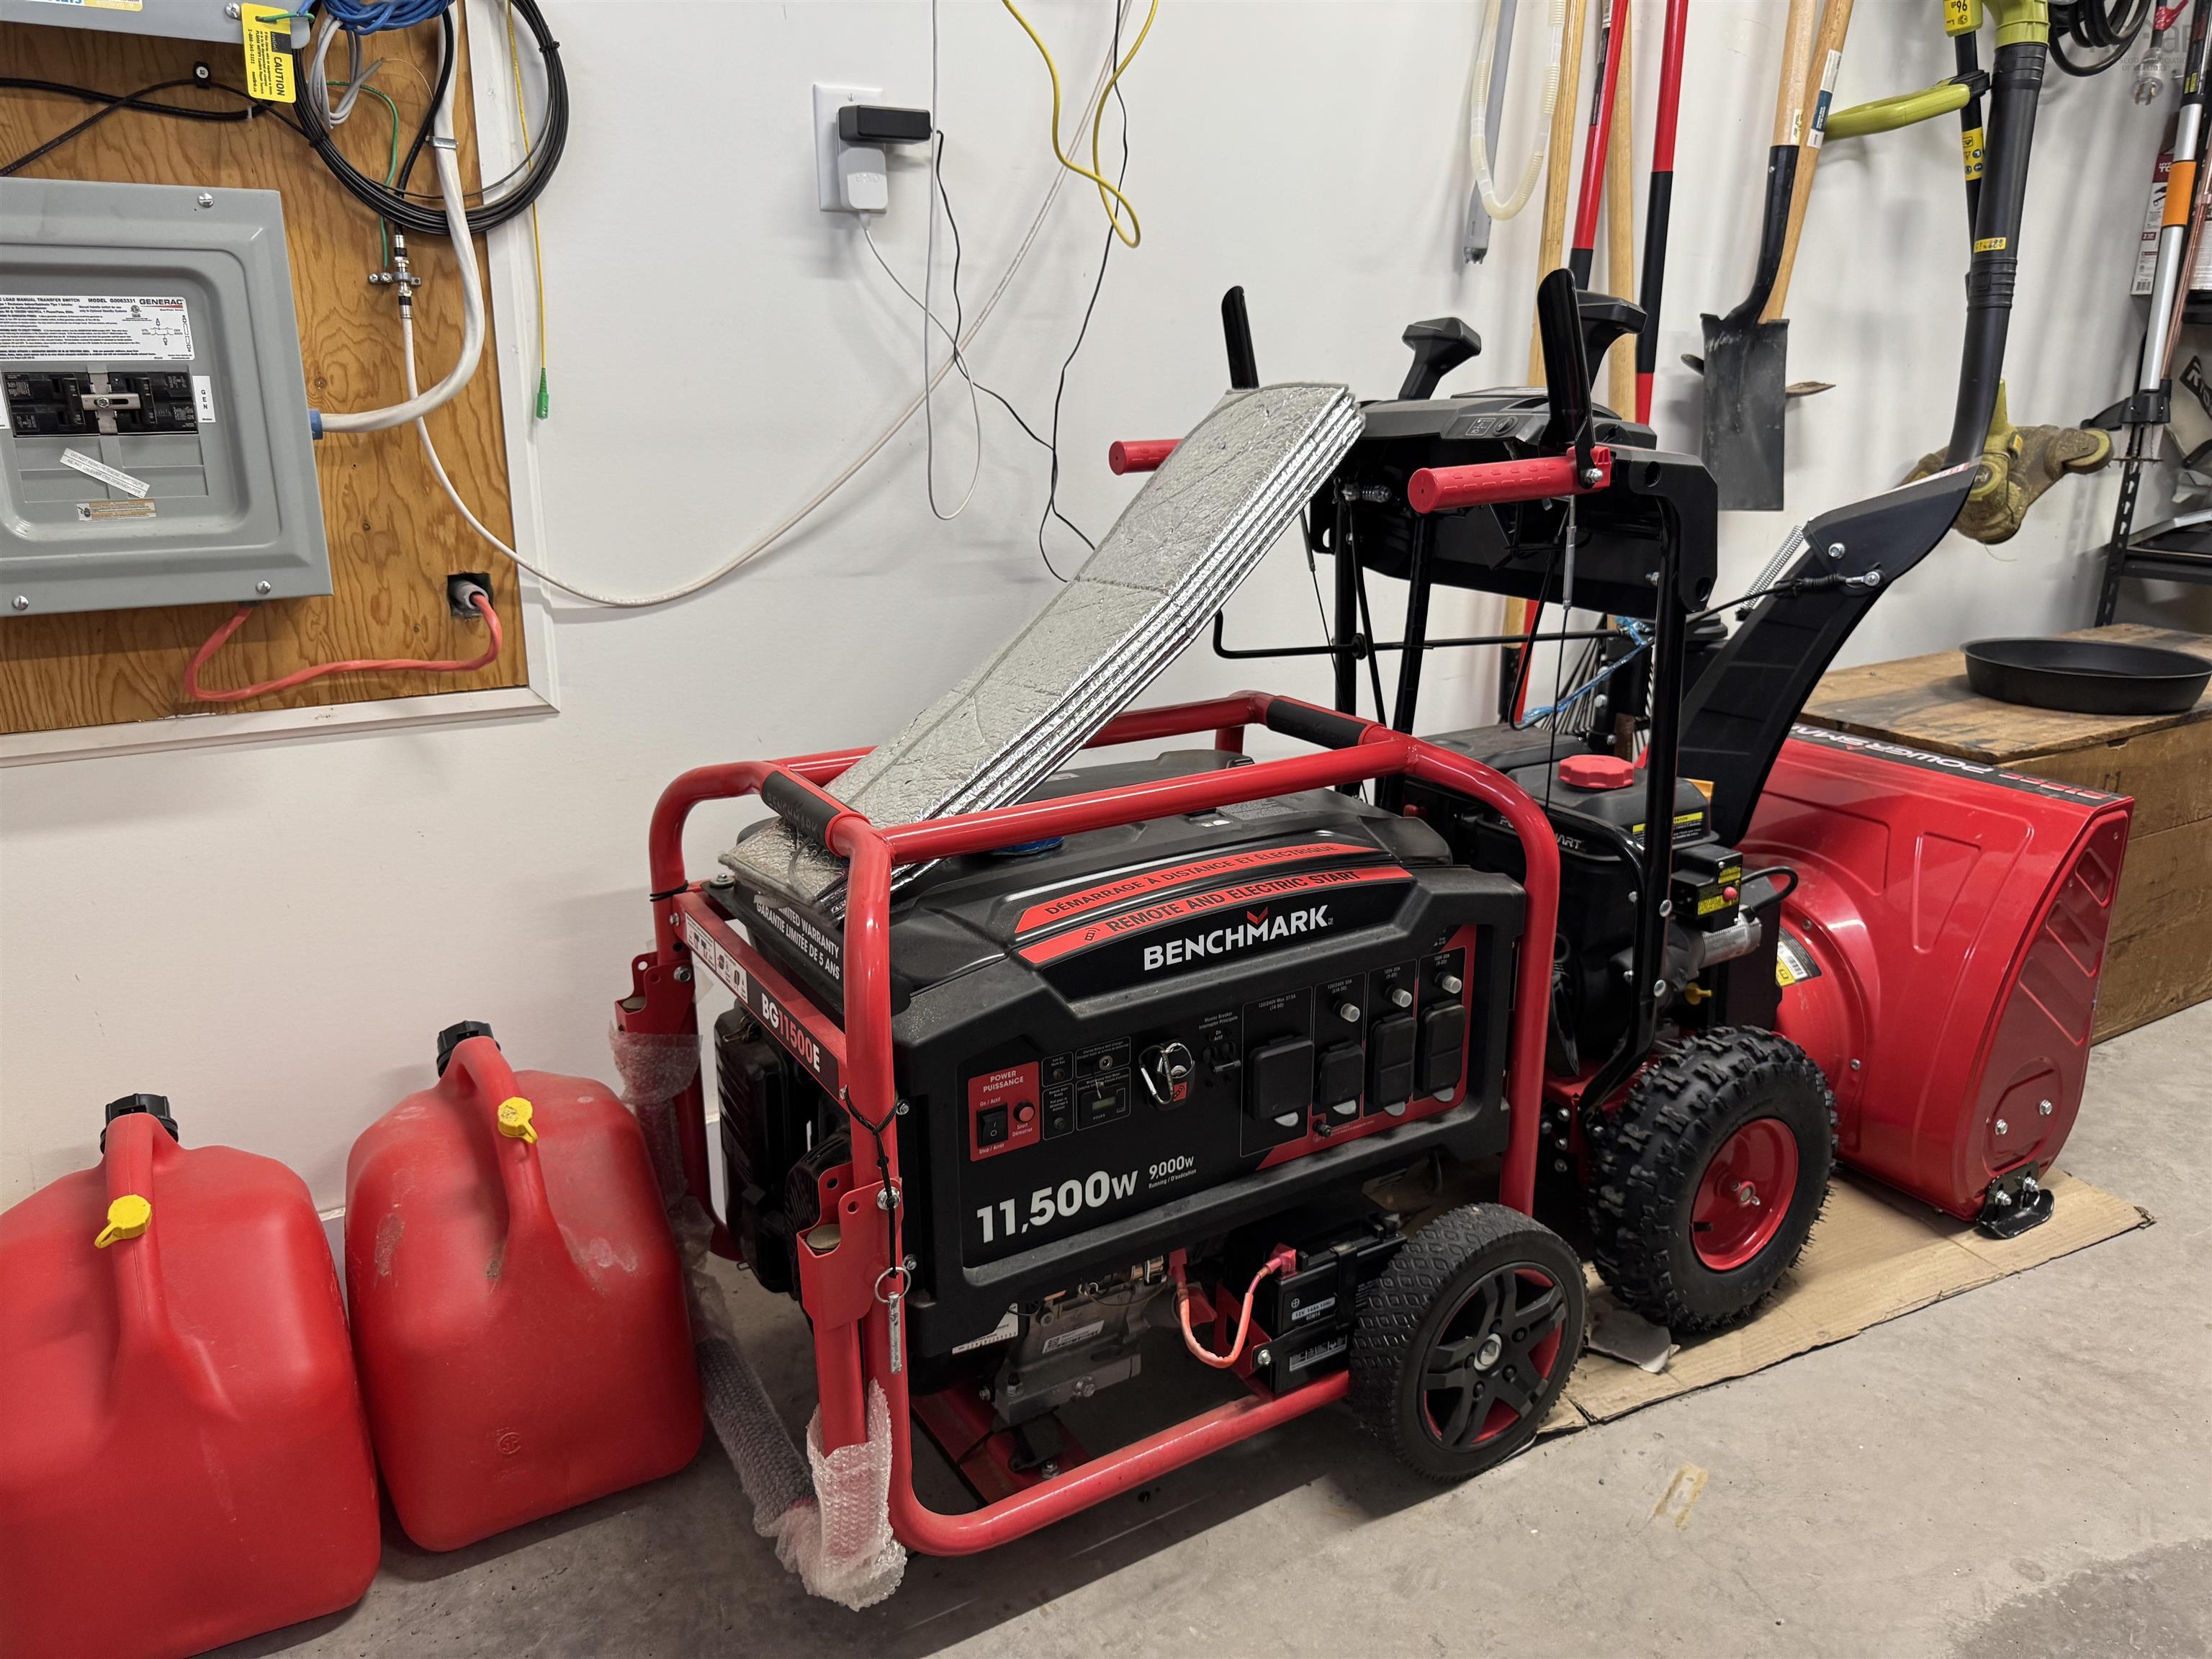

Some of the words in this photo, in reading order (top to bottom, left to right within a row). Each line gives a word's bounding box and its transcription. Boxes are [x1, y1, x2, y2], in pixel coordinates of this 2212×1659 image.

[274, 57, 285, 96] CAUTION
[1791, 725, 1994, 774] POWERSMA
[1044, 881, 1146, 917] DÉMARRAGE
[1146, 876, 1157, 886] À
[1160, 859, 1239, 882] DISTANCE
[1238, 855, 1253, 866] ET
[1256, 845, 1339, 863] ÉLECTRIQUE
[1107, 903, 1184, 932] REMOTE
[1186, 892, 1226, 910] AND
[1228, 875, 1308, 900] ELECTRIC
[1313, 870, 1360, 886] START
[756, 903, 785, 933] GARANTIE
[786, 924, 808, 953] LIMITÉE
[809, 943, 817, 961] DE
[819, 952, 824, 966] 5
[824, 958, 840, 979] ANS
[801, 918, 839, 959] WARRANTY
[1143, 904, 1329, 971] BENCHMARK
[762, 992, 820, 1072] BG11500E
[1204, 1014, 1218, 1022] Master
[983, 1076, 1024, 1092] PUISSANCE
[990, 1070, 1017, 1082] POWER
[1012, 1128, 1033, 1137] Démarrer
[1148, 1179, 1166, 1189] Running
